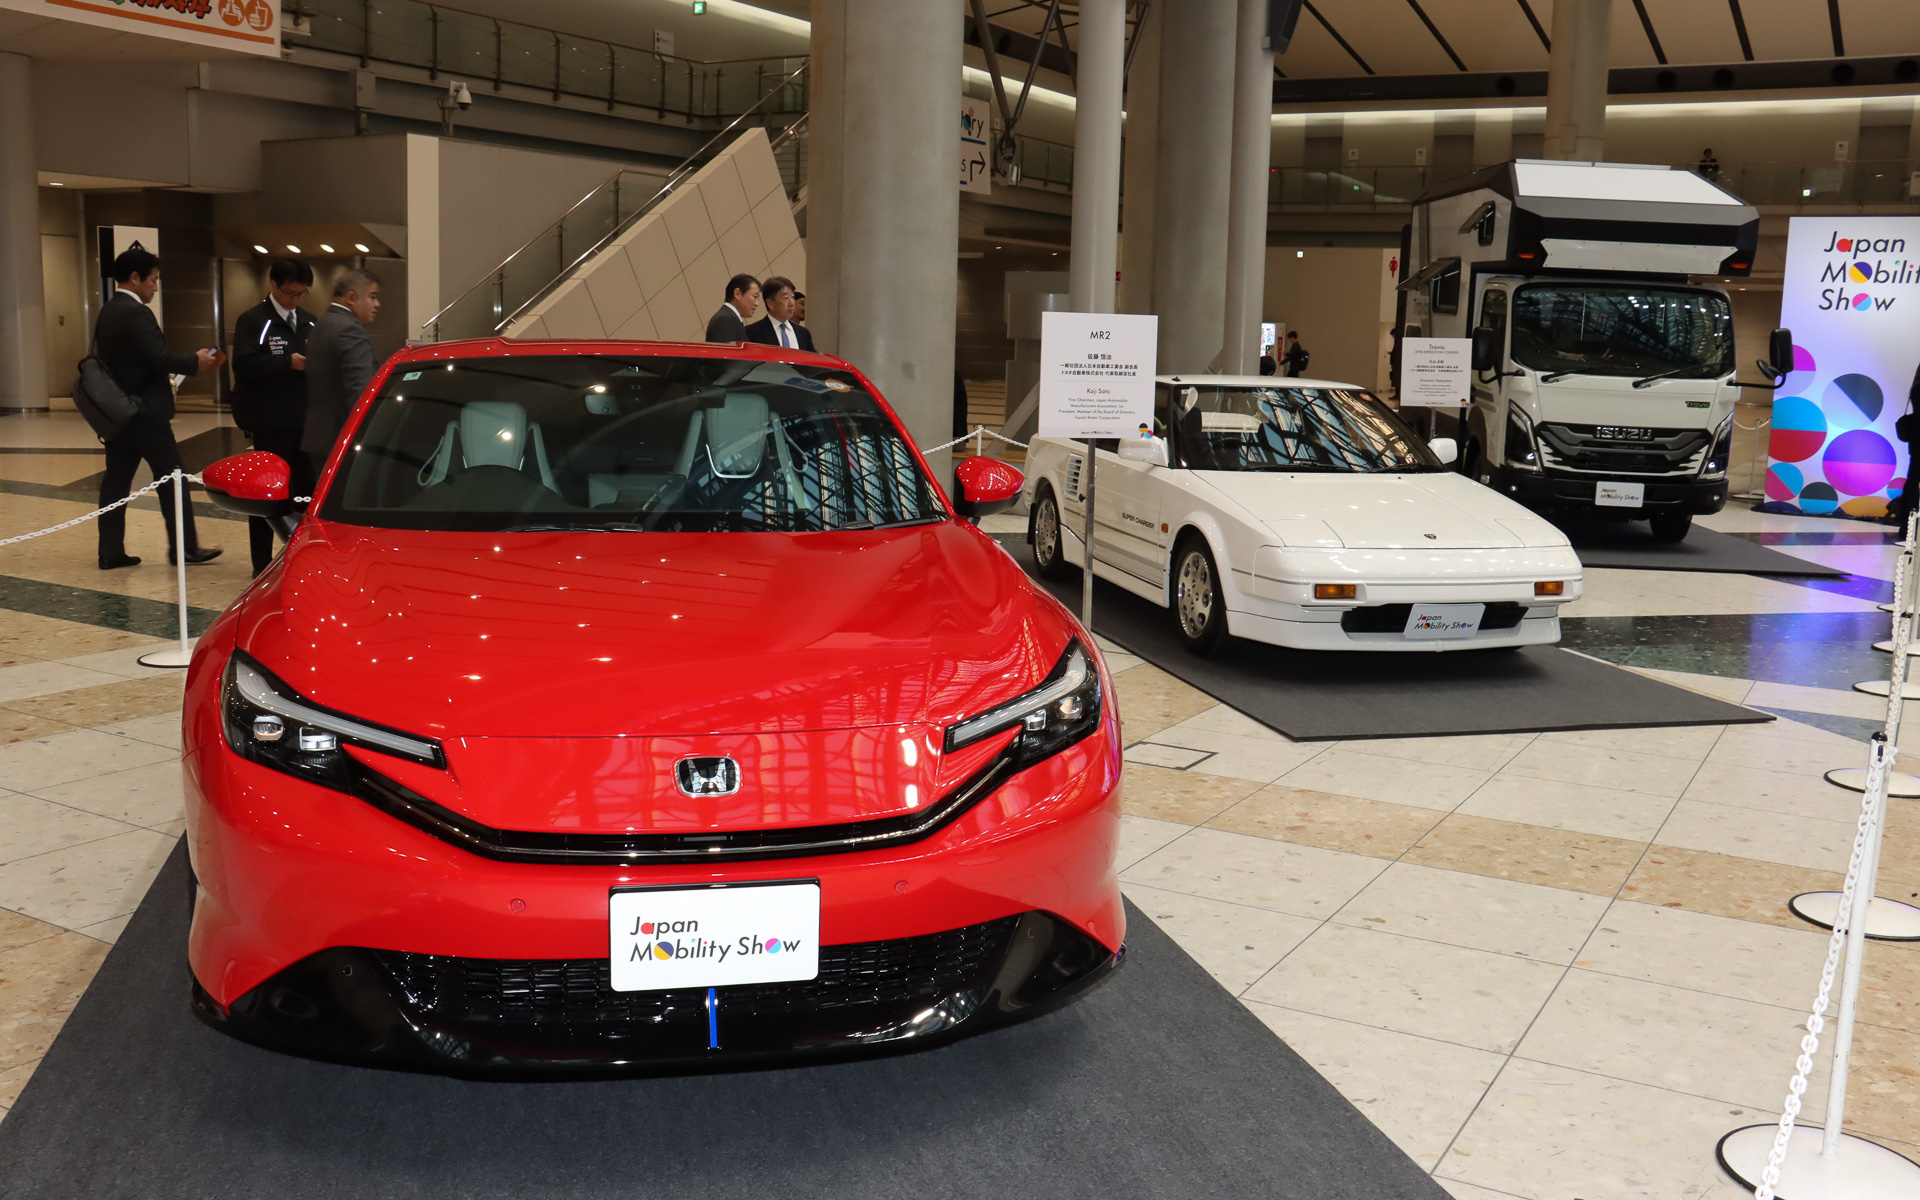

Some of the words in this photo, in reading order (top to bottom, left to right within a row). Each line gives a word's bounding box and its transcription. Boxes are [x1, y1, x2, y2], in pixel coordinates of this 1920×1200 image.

[1823, 230, 1906, 260] Japan
[1818, 287, 1896, 312] Show
[1089, 330, 1111, 340] MR2
[1685, 400, 1710, 409] Travio
[1596, 426, 1652, 440] ISUZU
[1600, 493, 1623, 501] Mobility
[1121, 512, 1135, 522] SUPER
[1135, 517, 1155, 530] CHARGER
[1417, 613, 1443, 622] Japan
[1413, 621, 1450, 631] Mobility
[1450, 621, 1474, 629] Show
[629, 916, 699, 940] Japan
[629, 937, 732, 963] Mobility
[736, 934, 802, 956] Show
